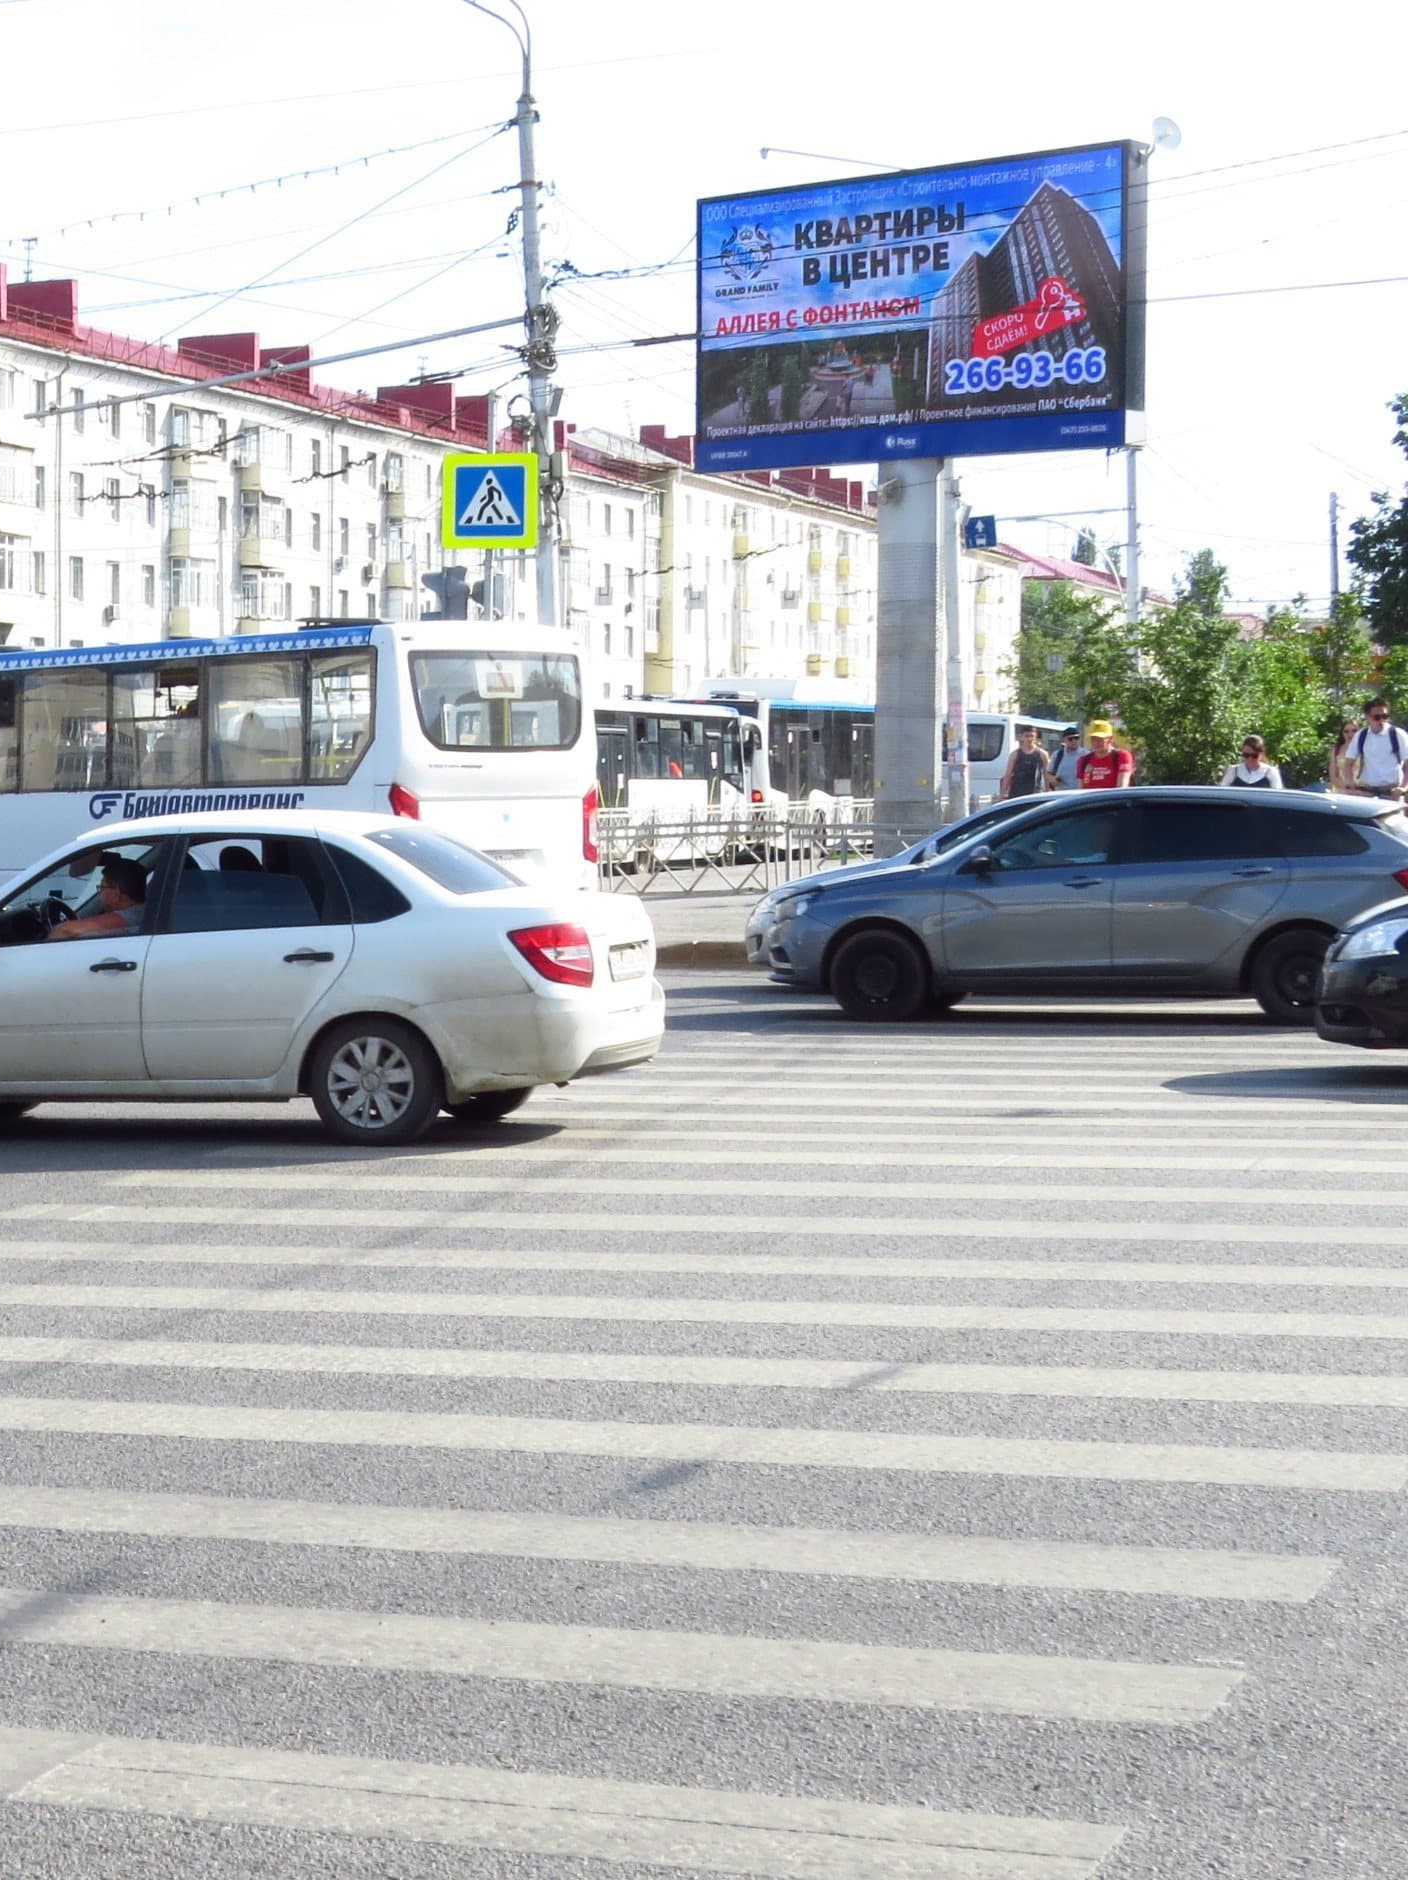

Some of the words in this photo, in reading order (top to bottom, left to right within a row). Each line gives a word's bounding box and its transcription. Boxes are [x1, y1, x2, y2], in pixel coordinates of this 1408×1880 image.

[706, 206, 728, 221] ООО
[1031, 159, 1094, 184] управление
[794, 203, 965, 250] КВАРТИРЫ
[803, 258, 821, 286] В
[829, 242, 950, 288] ЦЕНТРЕ
[715, 286, 746, 297] GRAND
[748, 282, 779, 294] FAMILY
[716, 311, 780, 336] АЛЛЕЯ
[786, 309, 797, 328] С
[803, 296, 920, 325] ФОНТАНОМ
[984, 313, 1024, 336] СКОРО
[946, 347, 1105, 392] 266-93-66
[706, 424, 747, 439] Проектная
[919, 405, 963, 422] Проектное
[965, 402, 1037, 420] финансирование
[1038, 398, 1057, 411] ПАО
[123, 792, 305, 819] Башавтотранс
